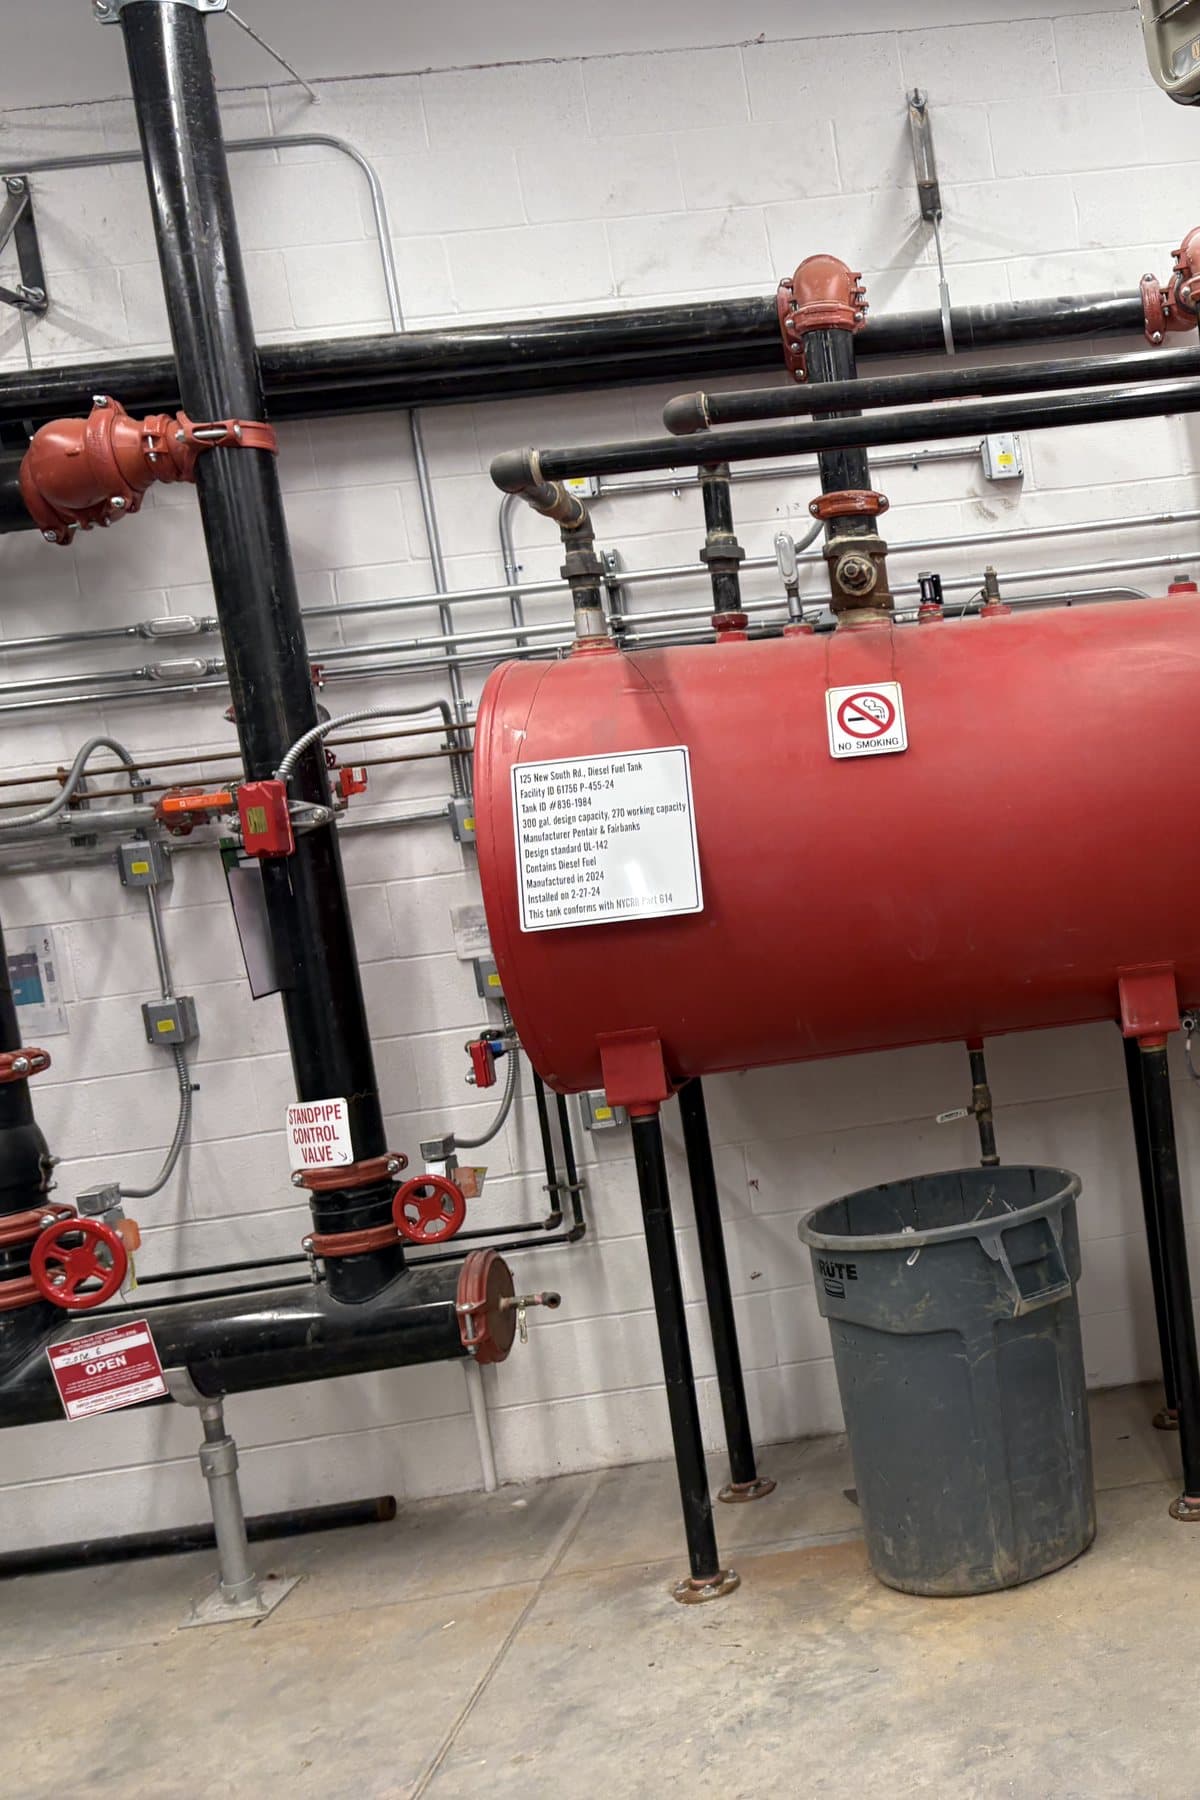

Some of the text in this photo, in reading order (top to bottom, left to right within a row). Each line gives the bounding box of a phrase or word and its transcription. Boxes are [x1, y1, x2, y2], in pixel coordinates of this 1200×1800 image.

[838, 737, 899, 751] NO SMOKING
[519, 773, 532, 784] 125
[533, 770, 549, 783] New
[550, 768, 571, 781] South
[587, 765, 610, 777] Diesel
[611, 763, 626, 774] Fuel
[627, 761, 643, 772] Tank
[520, 780, 615, 799] Facility ID 61756 P-455-24
[522, 802, 537, 814] Tank
[539, 801, 547, 812] ID
[522, 816, 537, 829] 300
[553, 813, 577, 826] design
[611, 807, 625, 818] 270
[626, 804, 655, 817] working
[655, 801, 687, 815] capacity
[523, 821, 641, 844] Manufacturer Pentair & Fairbanks
[524, 840, 609, 859] Design standard UL-142
[525, 856, 597, 874] Contains Diesel Fuel
[526, 870, 605, 889] Manufactured in 2024
[527, 886, 601, 904] Installed on 2-27-24
[528, 907, 544, 920] This
[545, 905, 562, 917] tank
[563, 902, 597, 915] conforms
[598, 900, 615, 912] with
[288, 1103, 343, 1125] STANDPIPE
[293, 1124, 340, 1145] CONTROL
[301, 1145, 334, 1163] VALVE
[817, 1259, 858, 1280] RUTE
[85, 1355, 128, 1376] OPEN
